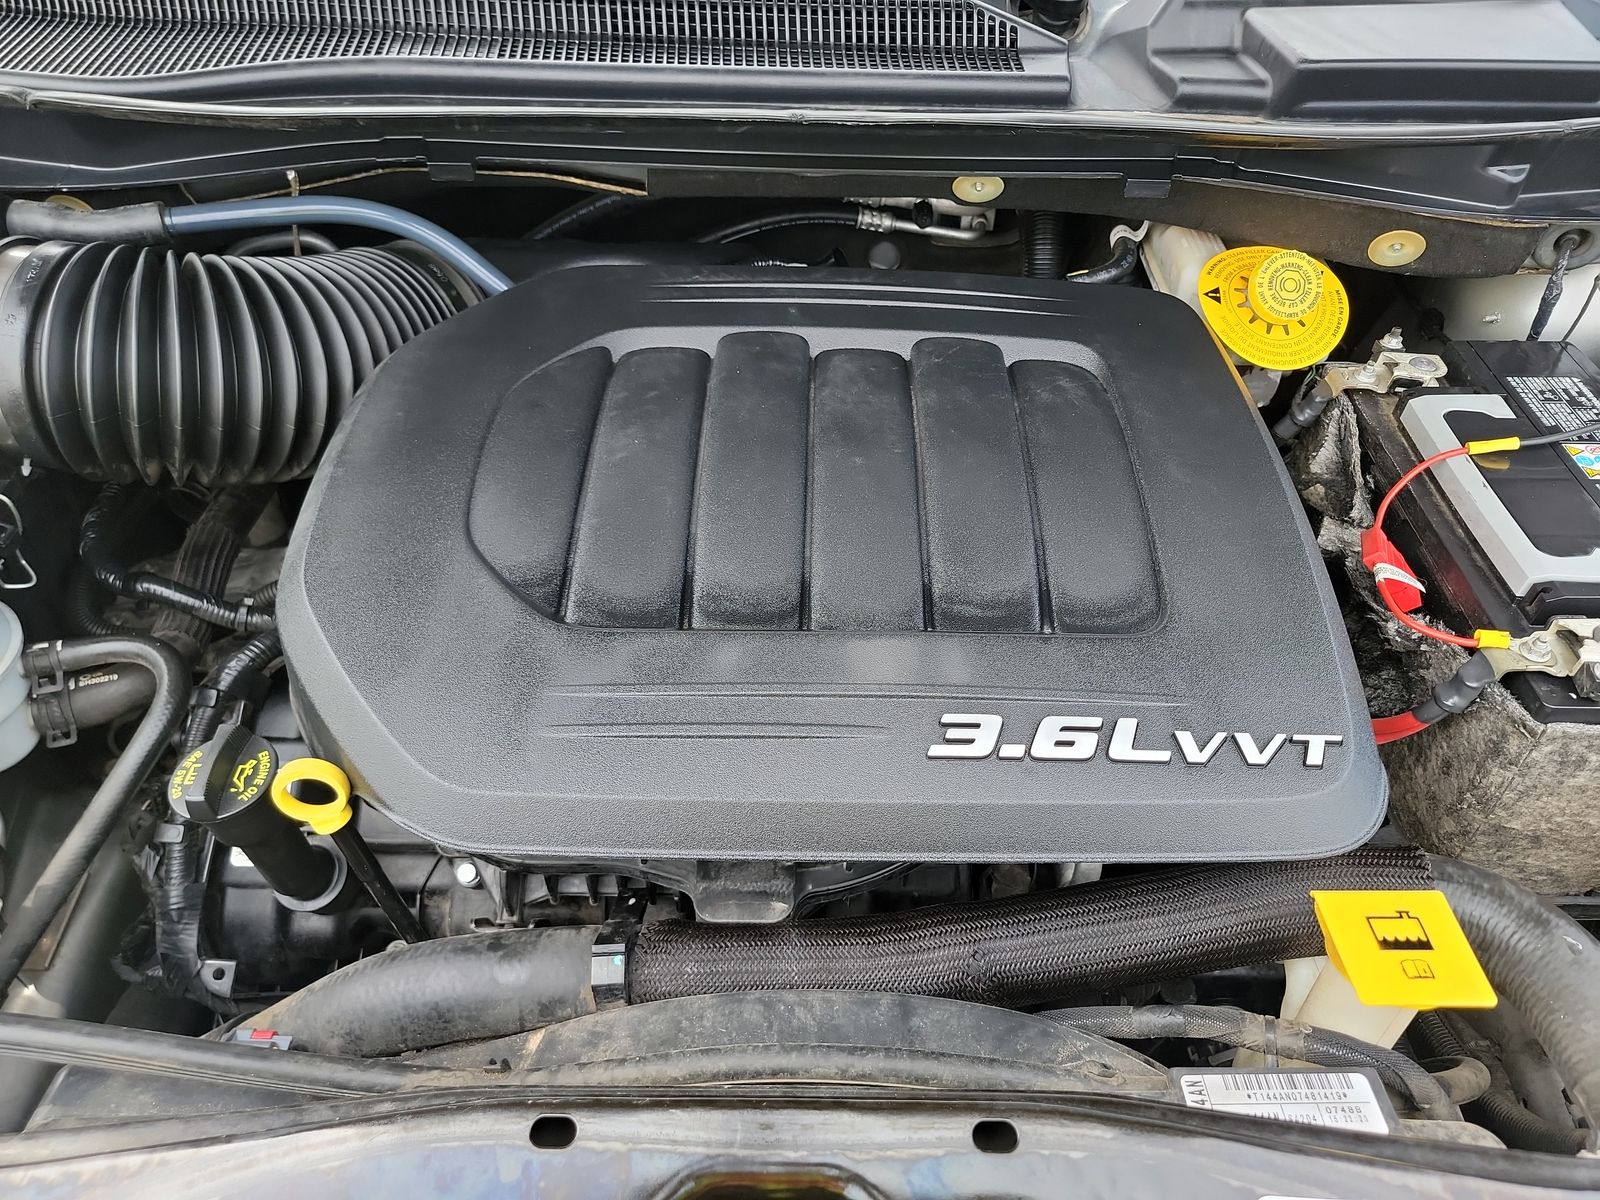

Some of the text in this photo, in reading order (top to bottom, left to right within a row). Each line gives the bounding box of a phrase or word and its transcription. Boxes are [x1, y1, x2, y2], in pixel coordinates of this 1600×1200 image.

[1333, 288, 1344, 305] MISE
[1337, 306, 1344, 315] EN
[171, 750, 203, 800] SAE 5W-20
[237, 750, 271, 801] ENGINE OIL
